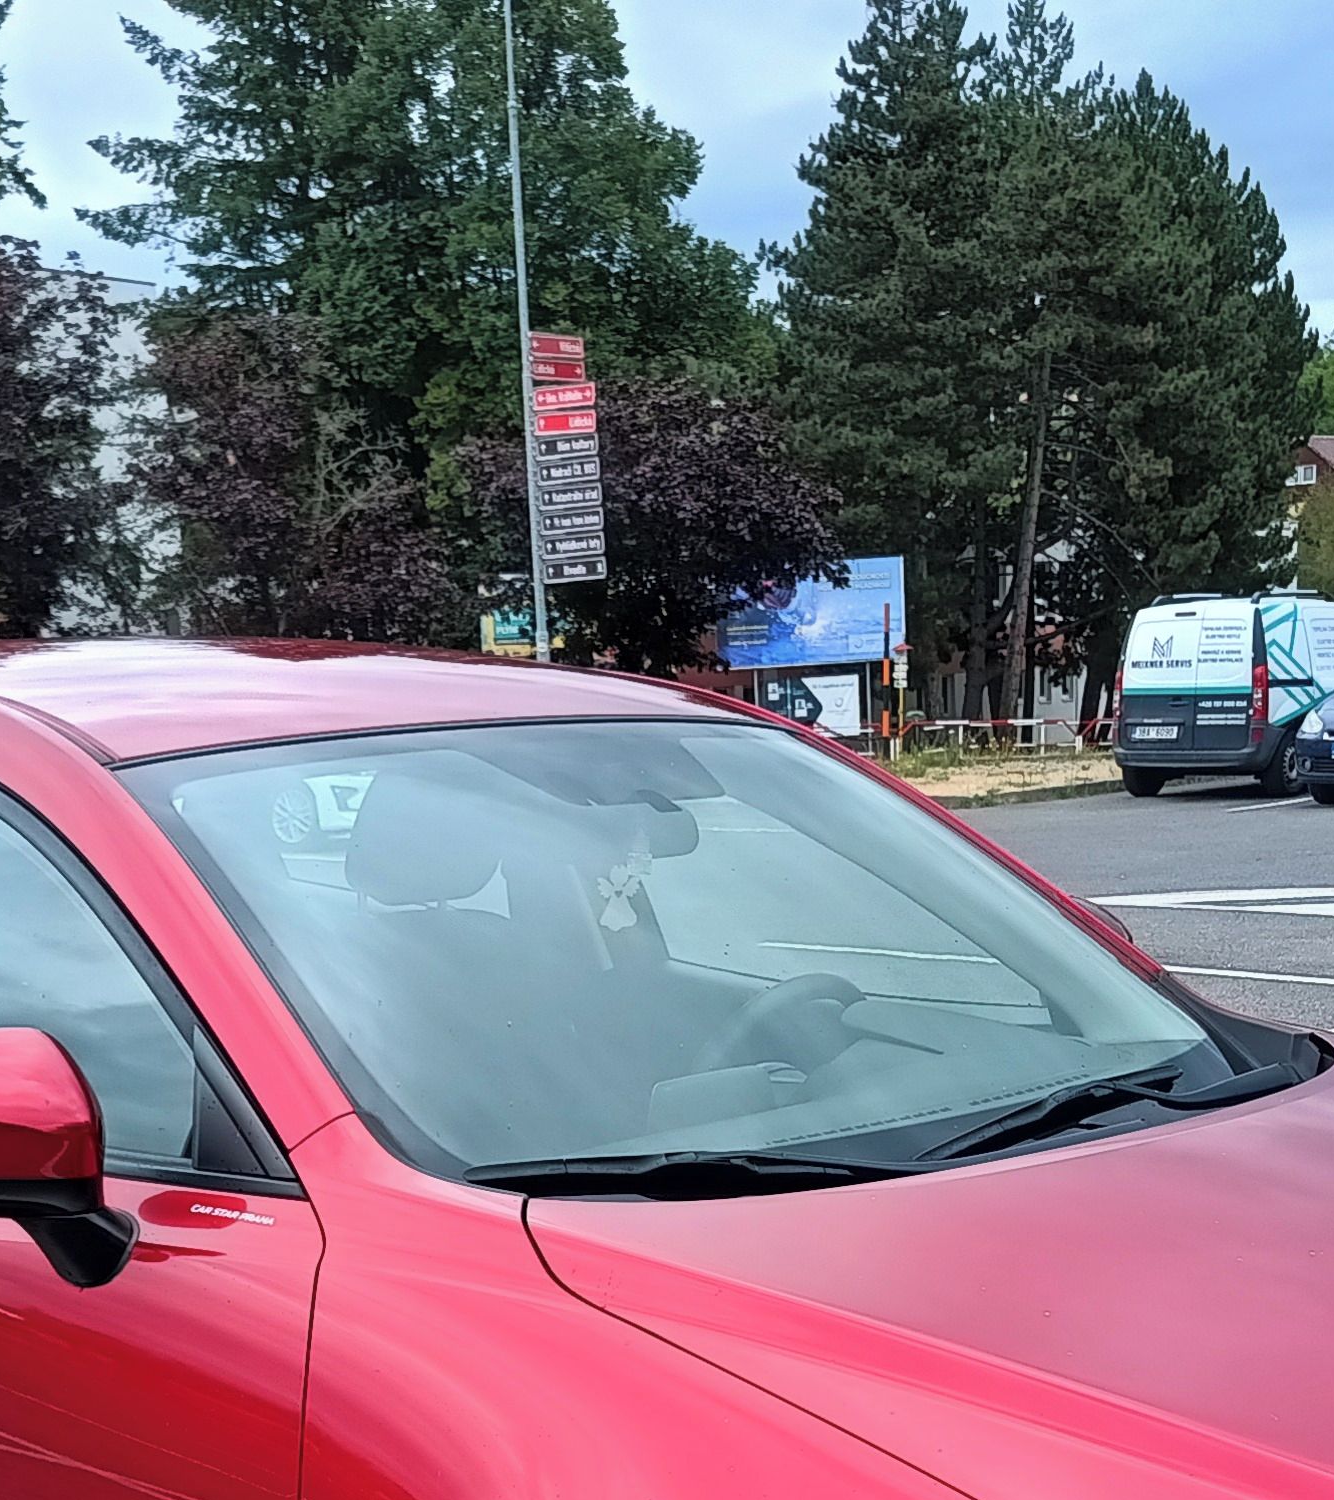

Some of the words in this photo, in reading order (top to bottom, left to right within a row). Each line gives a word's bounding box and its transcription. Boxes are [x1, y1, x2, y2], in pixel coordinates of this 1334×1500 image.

[1131, 660, 1164, 669] MEIXNER
[1166, 659, 1193, 669] SERVIS
[211, 1207, 240, 1219] STAR
